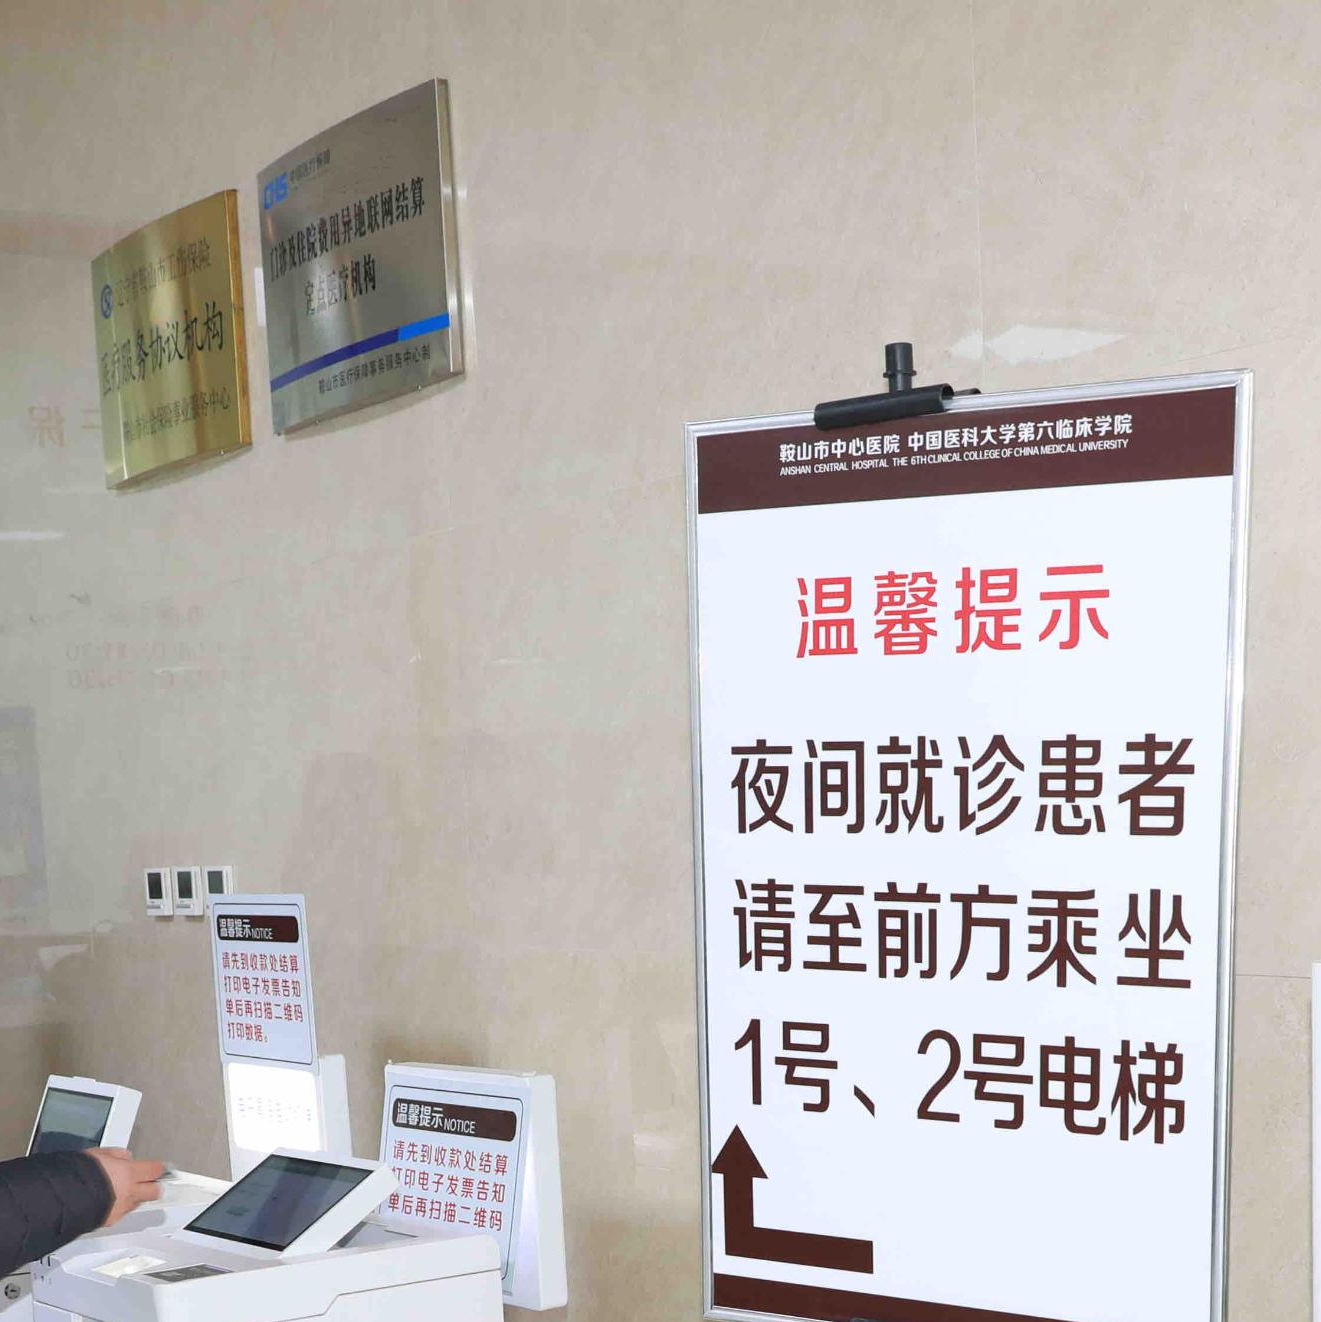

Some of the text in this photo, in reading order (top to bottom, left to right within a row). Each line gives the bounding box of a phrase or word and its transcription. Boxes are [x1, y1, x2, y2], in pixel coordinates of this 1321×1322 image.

[270, 176, 425, 282] 门诊及住院费用异地联网结算
[305, 253, 376, 315] 定点医疗机构
[101, 301, 224, 397] 医疗服务协议机构
[779, 413, 1133, 463] 鞍山市中心医院 中国医科大学第六临床学院
[780, 439, 1129, 476] ANSHAN CENTRAL HOSPITAL THE 6TH CLINICAL COLLEGE OF CHINA MEDICAL UNIVERSITY
[795, 564, 1112, 660] 温馨提示
[730, 733, 1195, 836] 夜间就诊患者
[219, 918, 274, 939] 温馨提示 NOTICE
[733, 878, 1192, 989] 请至前方乘坐
[222, 952, 299, 974] 请先到收款处结算
[224, 976, 301, 997] 打印电子发票告知
[225, 999, 304, 1023] 单后再扫描二维码
[227, 1022, 269, 1043] 打印数据。
[734, 1019, 1186, 1145] 1号、2号电梯
[396, 1102, 476, 1134] 温馨提示 NOTICE
[393, 1140, 509, 1176] 请先到收款处结算
[391, 1166, 506, 1203] 打印电子发票告知
[388, 1192, 503, 1232] 单后再扫描二维码
